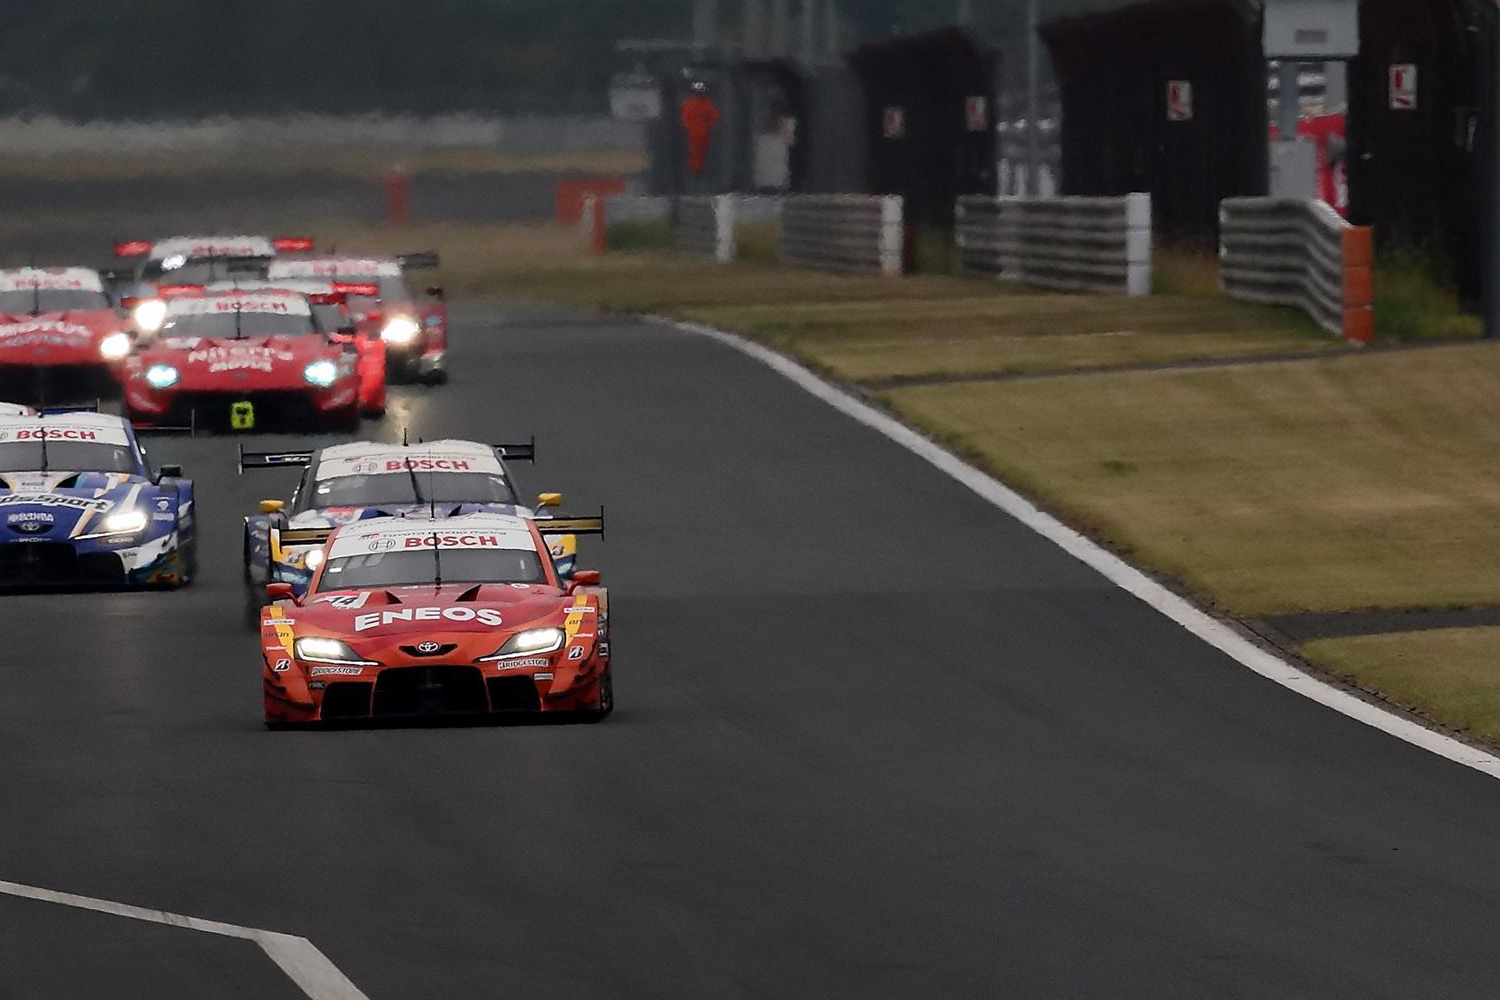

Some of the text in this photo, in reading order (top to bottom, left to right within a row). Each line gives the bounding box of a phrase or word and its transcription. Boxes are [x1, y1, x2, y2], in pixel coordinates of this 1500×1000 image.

[16, 429, 96, 440] BOSCH
[385, 459, 470, 471] BOSCH
[404, 535, 499, 548] BOSCH
[355, 606, 503, 632] ENEOS
